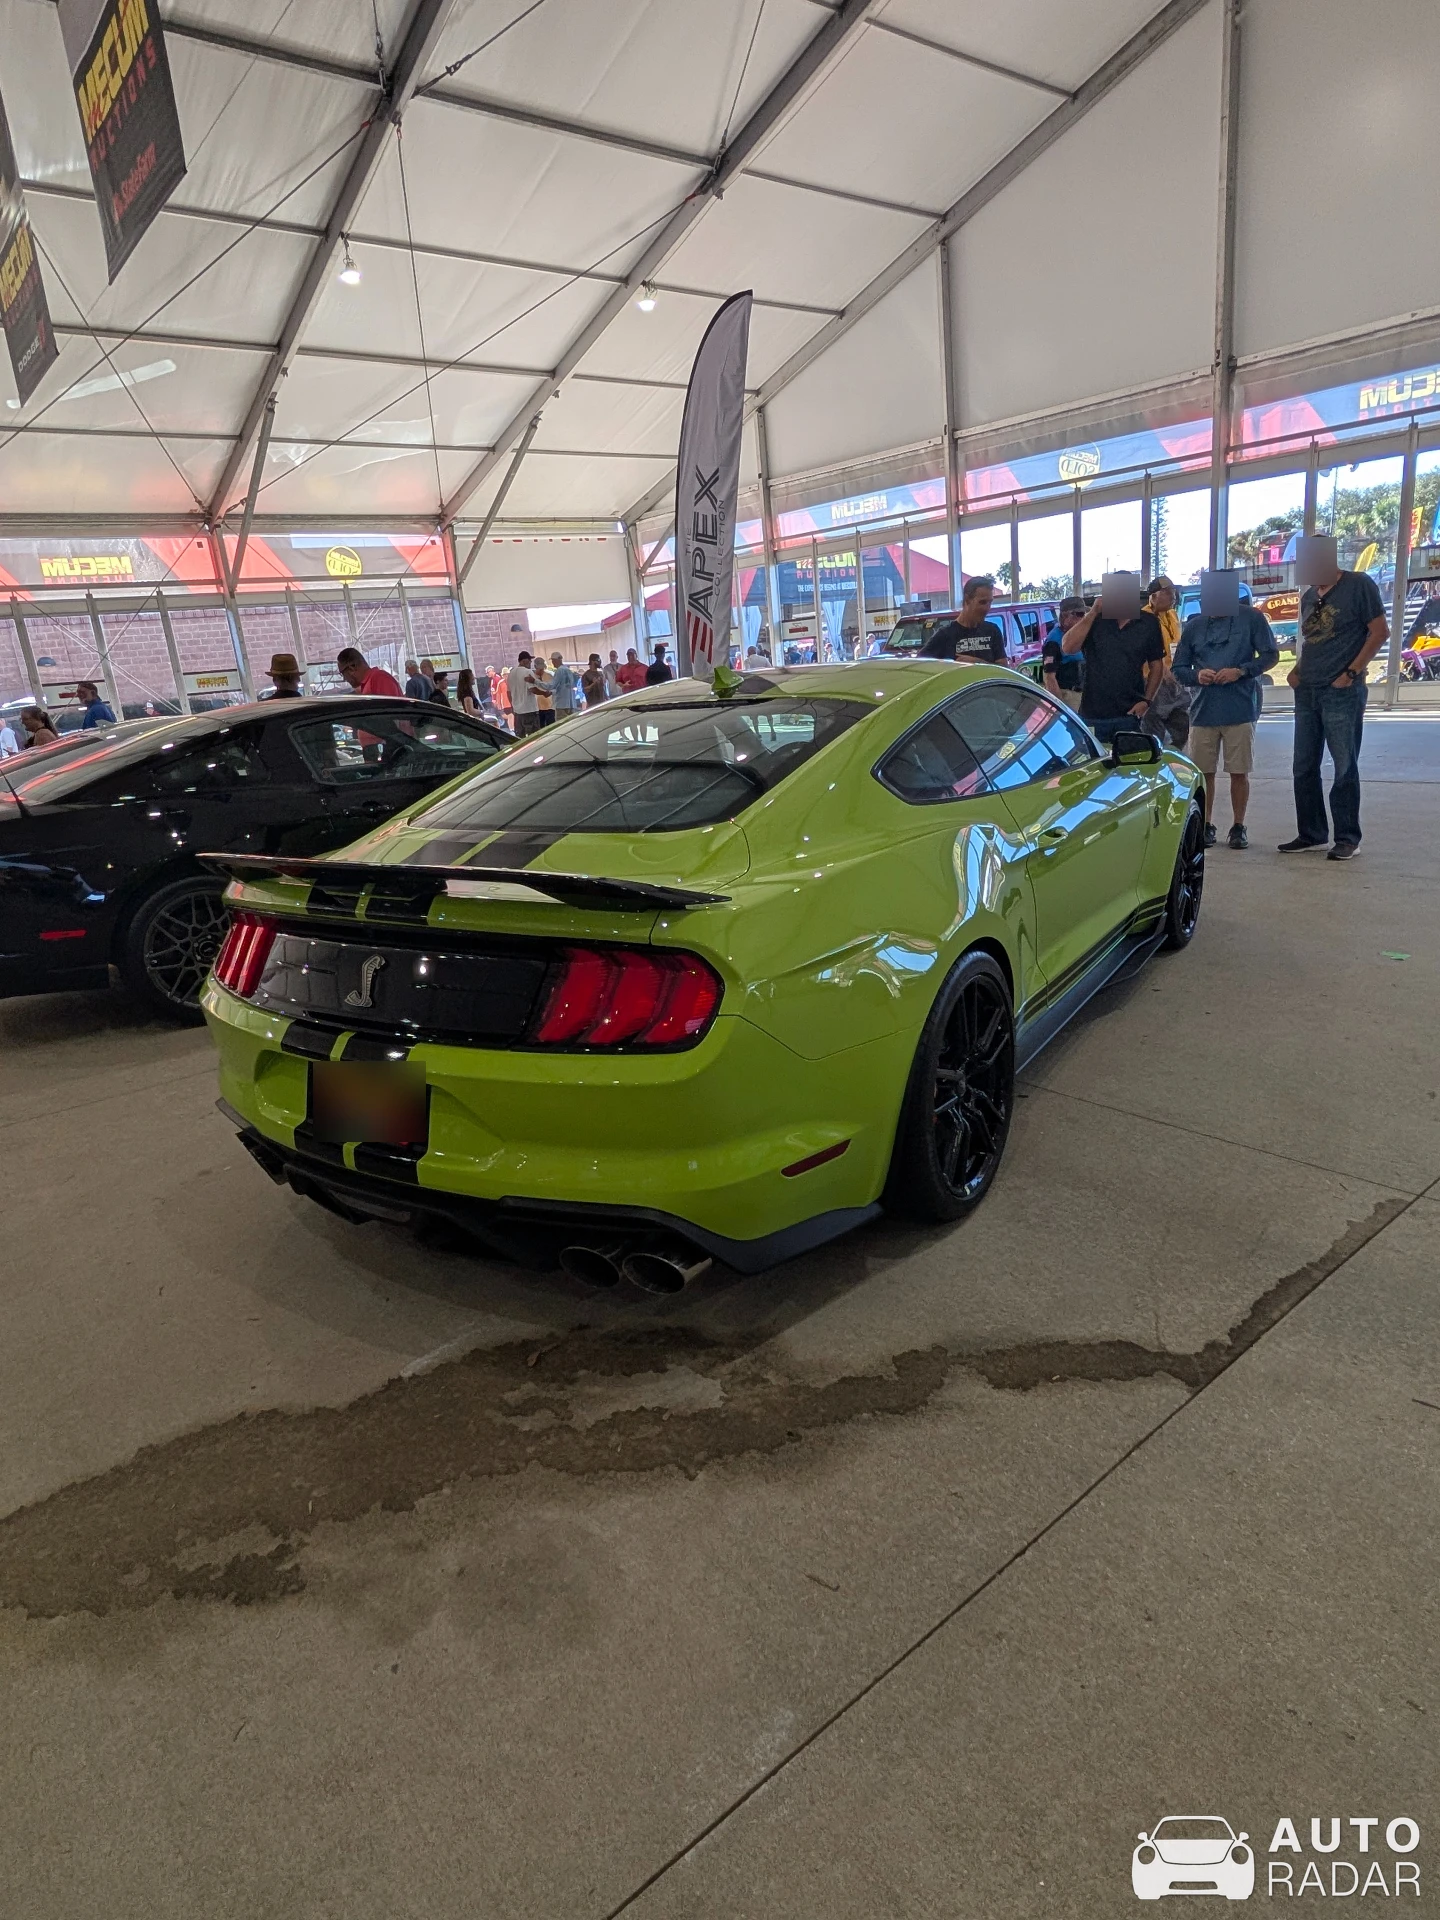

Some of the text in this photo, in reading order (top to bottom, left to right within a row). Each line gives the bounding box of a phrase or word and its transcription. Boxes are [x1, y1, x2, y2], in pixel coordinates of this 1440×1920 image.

[78, 0, 149, 146] MECUM
[18, 334, 41, 374] DODGE
[688, 464, 720, 625] APEX
[714, 499, 726, 597] COLLECTION
